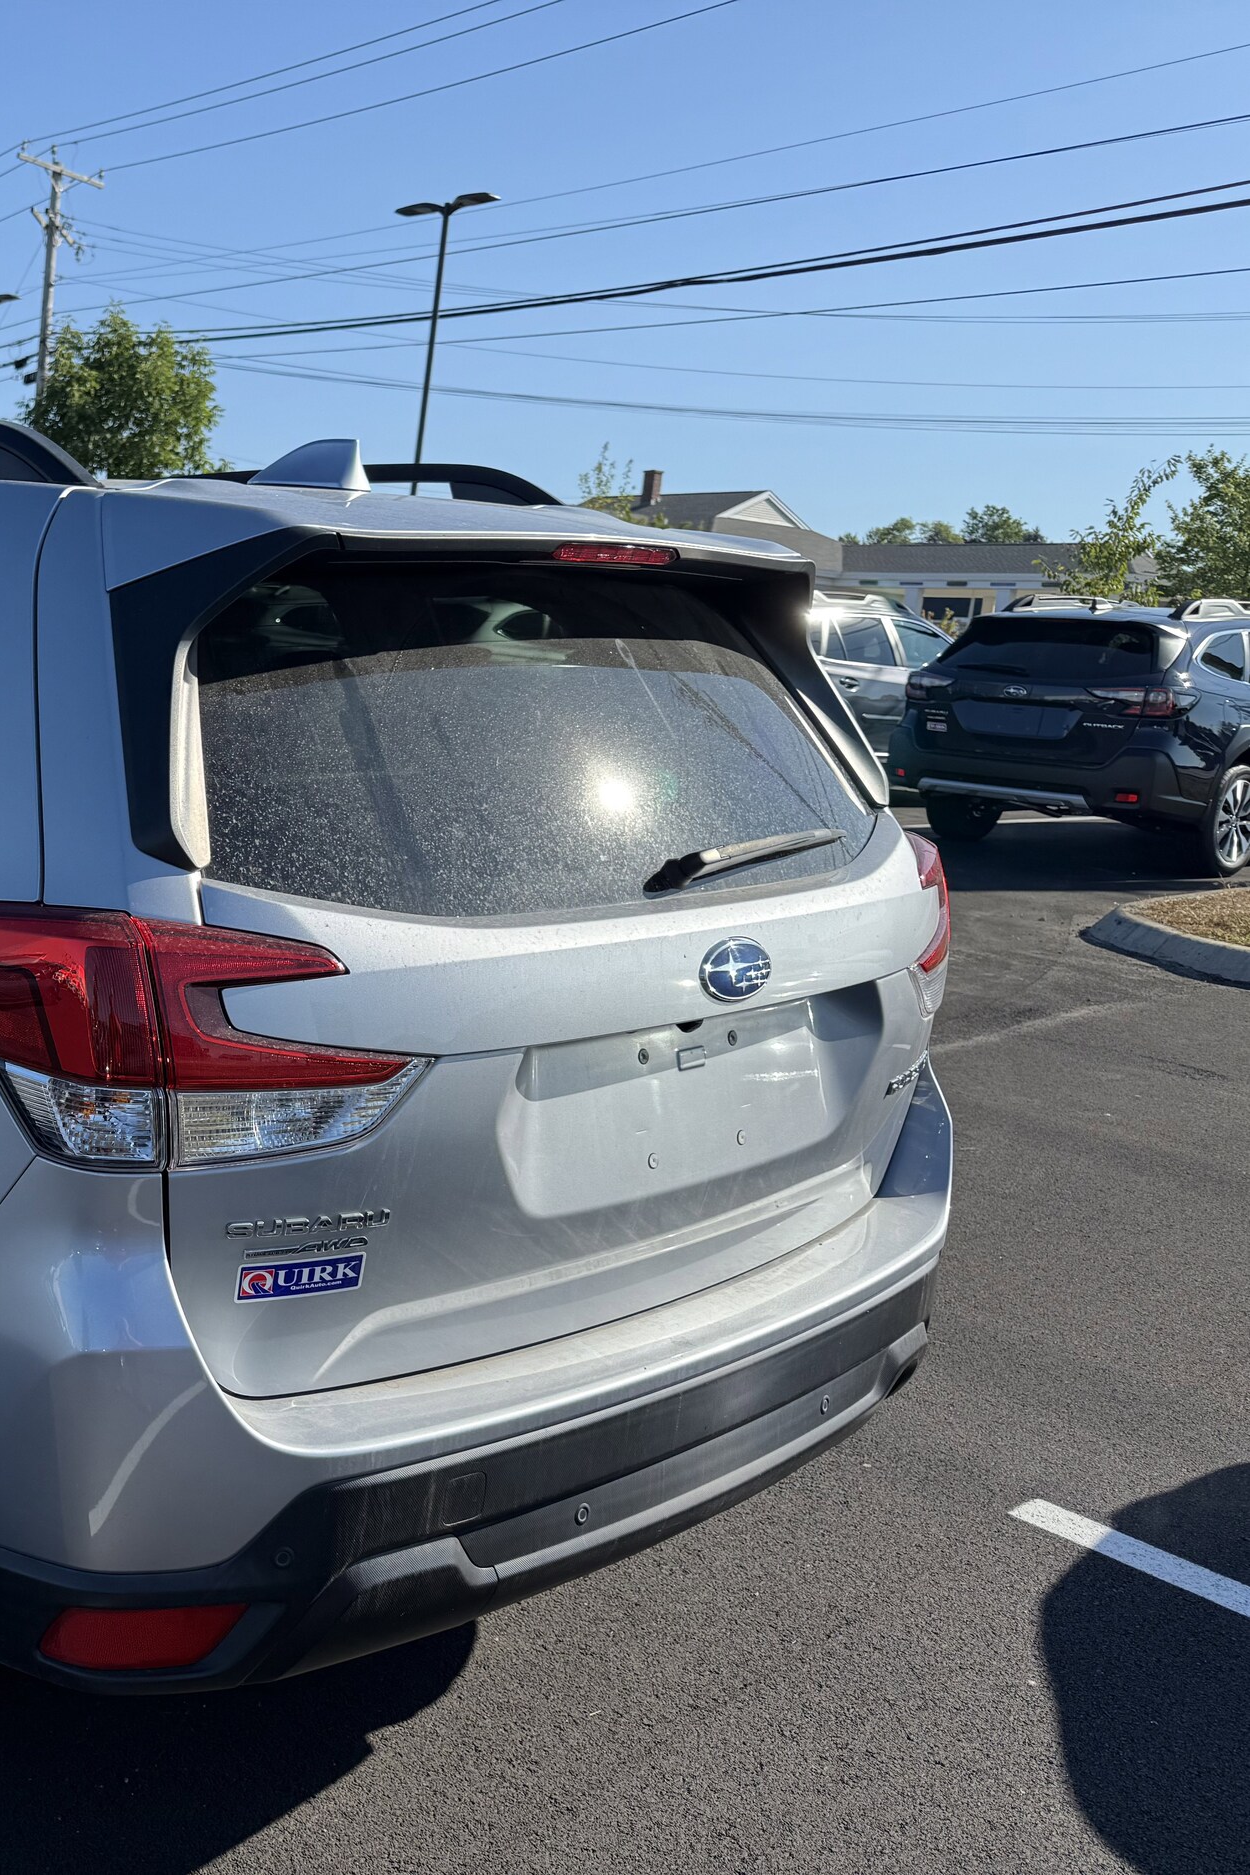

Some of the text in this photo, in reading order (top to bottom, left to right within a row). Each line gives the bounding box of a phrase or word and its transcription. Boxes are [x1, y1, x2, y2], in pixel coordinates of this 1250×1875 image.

[226, 1208, 391, 1239] SUBARU
[291, 1235, 369, 1255] AWD
[242, 1261, 359, 1294] QUIRK
[290, 1280, 342, 1291] QuirkAuto.com
